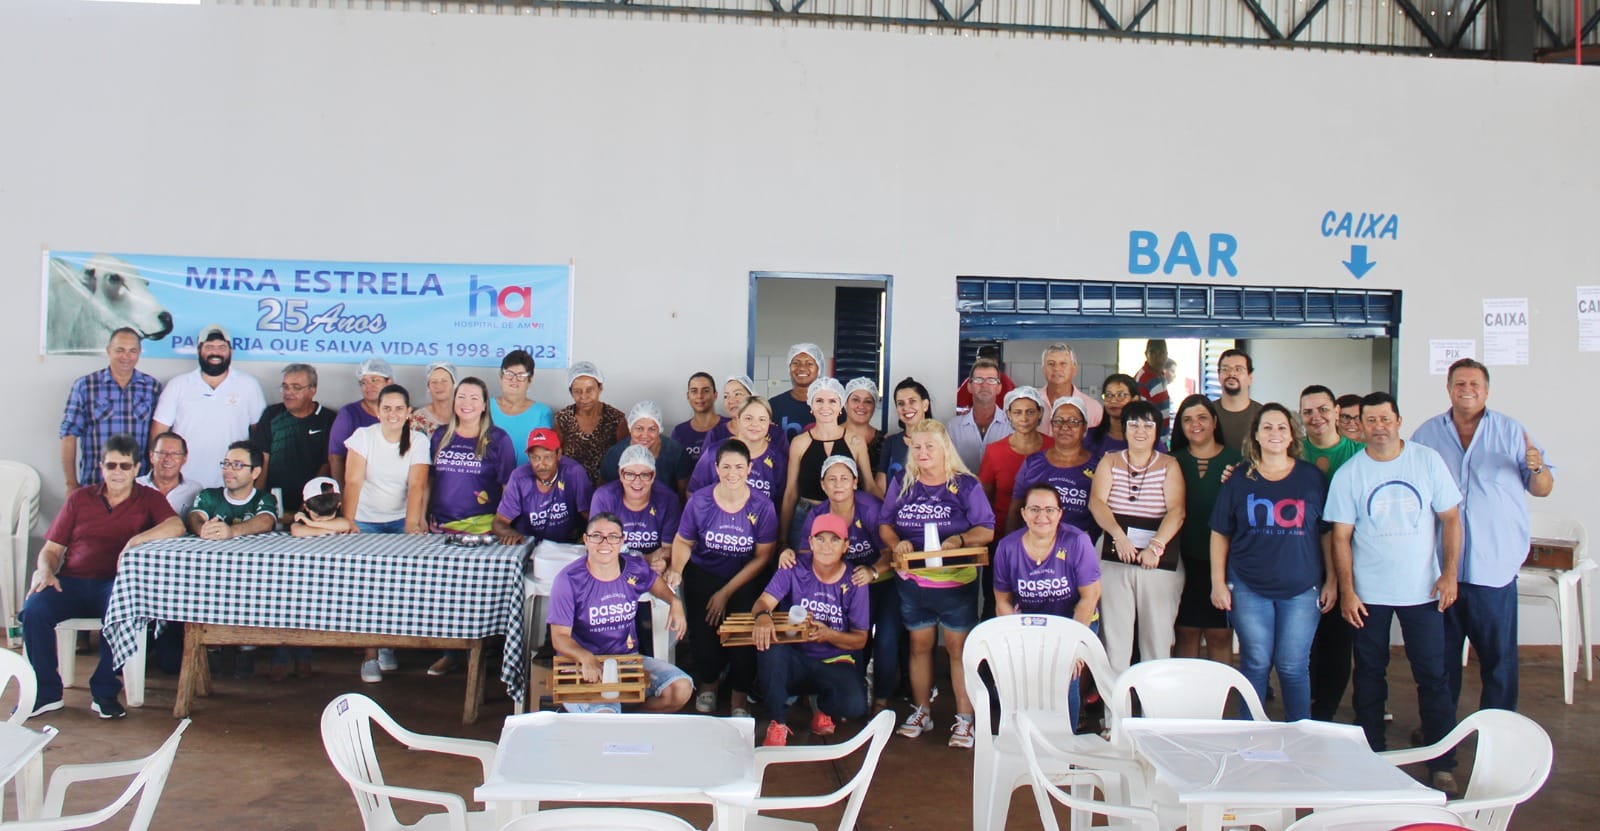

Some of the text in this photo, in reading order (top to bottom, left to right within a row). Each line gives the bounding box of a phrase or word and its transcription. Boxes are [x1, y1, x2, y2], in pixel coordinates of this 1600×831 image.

[1320, 210, 1399, 240] CAIXA
[1128, 230, 1238, 277] BAR
[185, 266, 444, 296] MIRA ESTRELA
[468, 274, 532, 318] ha
[256, 297, 387, 334] 25 Anos
[454, 320, 499, 329] HOSPITAL
[502, 321, 515, 329] DE
[1484, 312, 1527, 327] CAIXA
[172, 335, 263, 351] PARIA
[270, 338, 310, 355] QUE
[314, 339, 375, 355] SALVA
[381, 341, 439, 356] VIDAS
[447, 342, 490, 358] 1998
[1445, 349, 1460, 358] PIX
[1247, 493, 1305, 528] ha
[705, 530, 755, 547] passos
[1017, 576, 1068, 592] passos
